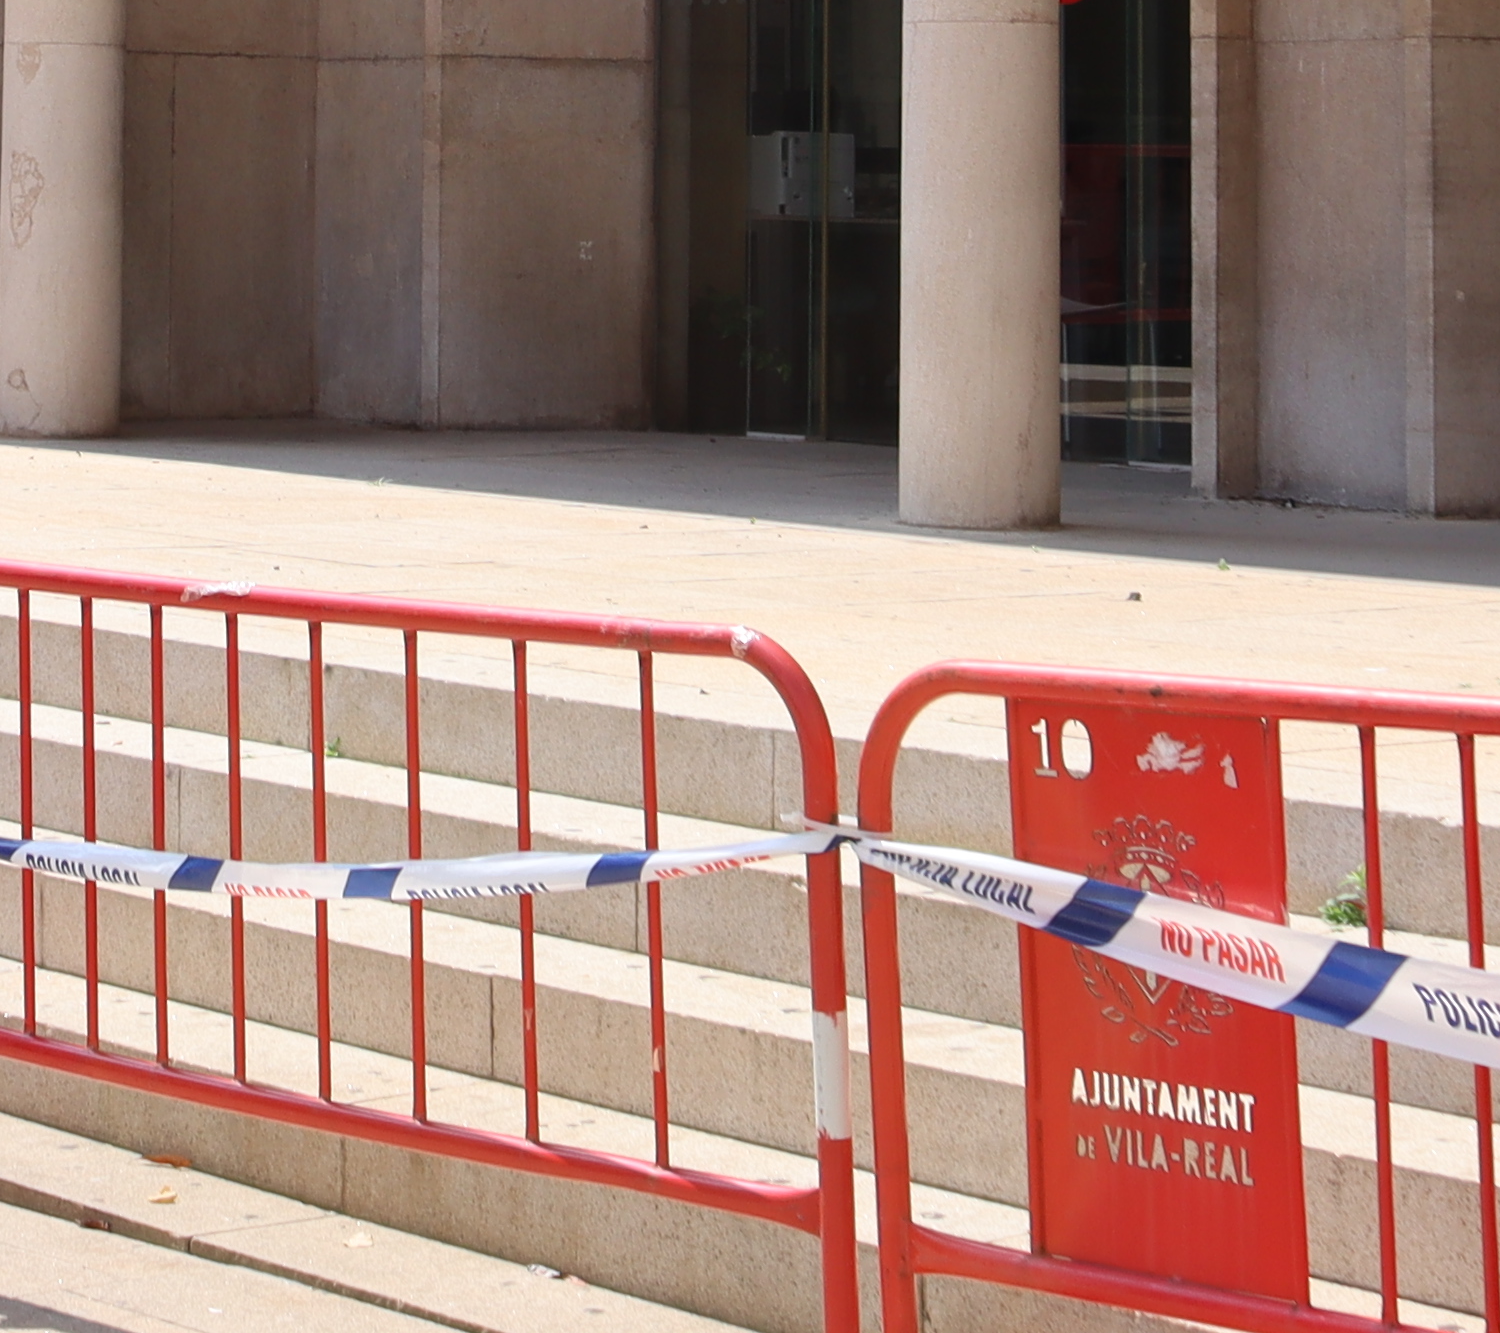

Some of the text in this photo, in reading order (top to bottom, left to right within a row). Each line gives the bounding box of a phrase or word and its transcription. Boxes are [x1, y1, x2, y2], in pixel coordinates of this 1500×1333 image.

[1031, 717, 1093, 780] 10
[1156, 916, 1287, 984] NO PASAR
[1072, 1067, 1256, 1134] AJUNTAMENT
[1076, 1124, 1255, 1187] DE VILA-REAL
